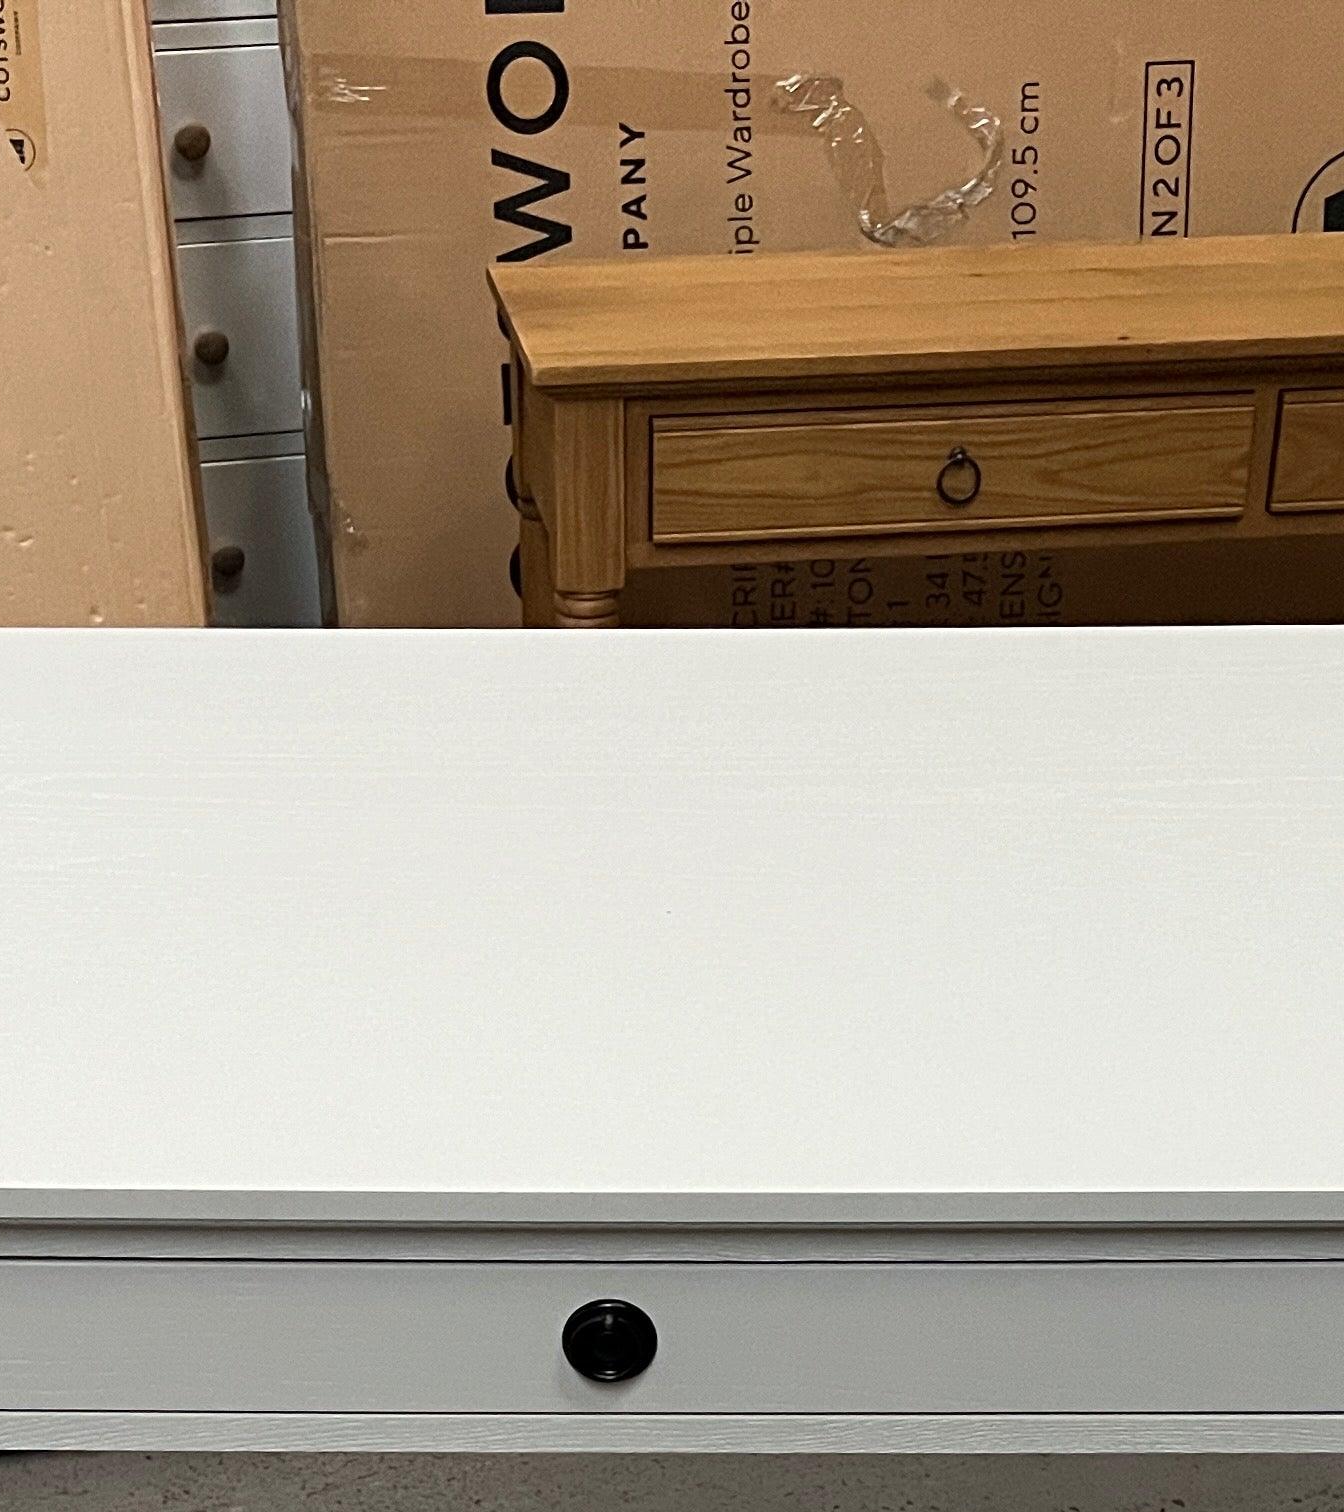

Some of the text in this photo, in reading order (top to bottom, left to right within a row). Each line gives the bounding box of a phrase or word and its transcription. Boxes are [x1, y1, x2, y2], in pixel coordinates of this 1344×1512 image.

[724, 1, 753, 184] Wardrobe
[1157, 77, 1184, 97] 3
[1011, 82, 1040, 240] 109.5 cm
[1154, 108, 1182, 165] OF
[1153, 177, 1180, 197] 2
